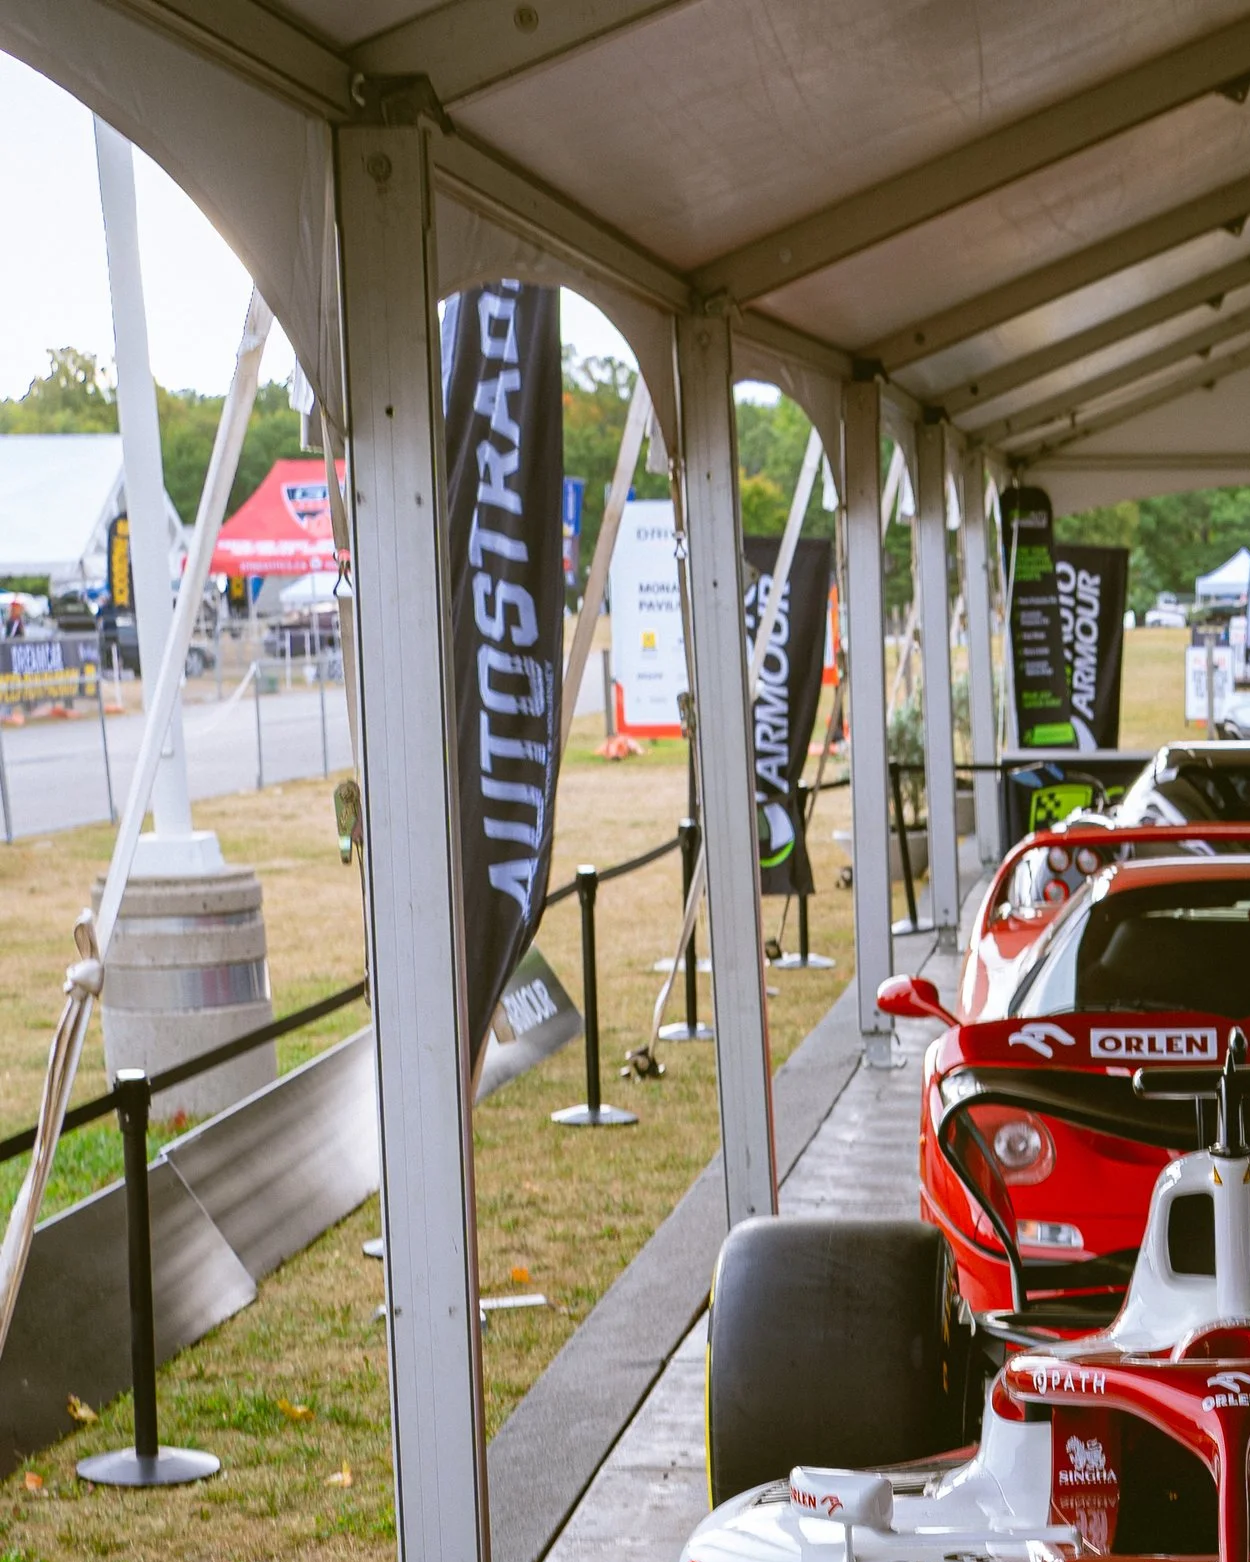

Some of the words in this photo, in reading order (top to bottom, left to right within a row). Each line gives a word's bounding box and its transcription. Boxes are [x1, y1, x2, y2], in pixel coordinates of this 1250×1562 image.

[638, 583, 680, 595] MONA
[469, 278, 545, 926] AUTOSTRAD
[638, 602, 681, 613] PAVIL
[1070, 569, 1102, 722] ARMOUR
[755, 573, 790, 795] ARMOUR
[1097, 1031, 1211, 1057] ORLEN
[1052, 1369, 1106, 1394] PATH
[1058, 1467, 1118, 1484] SINGHA
[790, 1488, 817, 1510] RLEN
